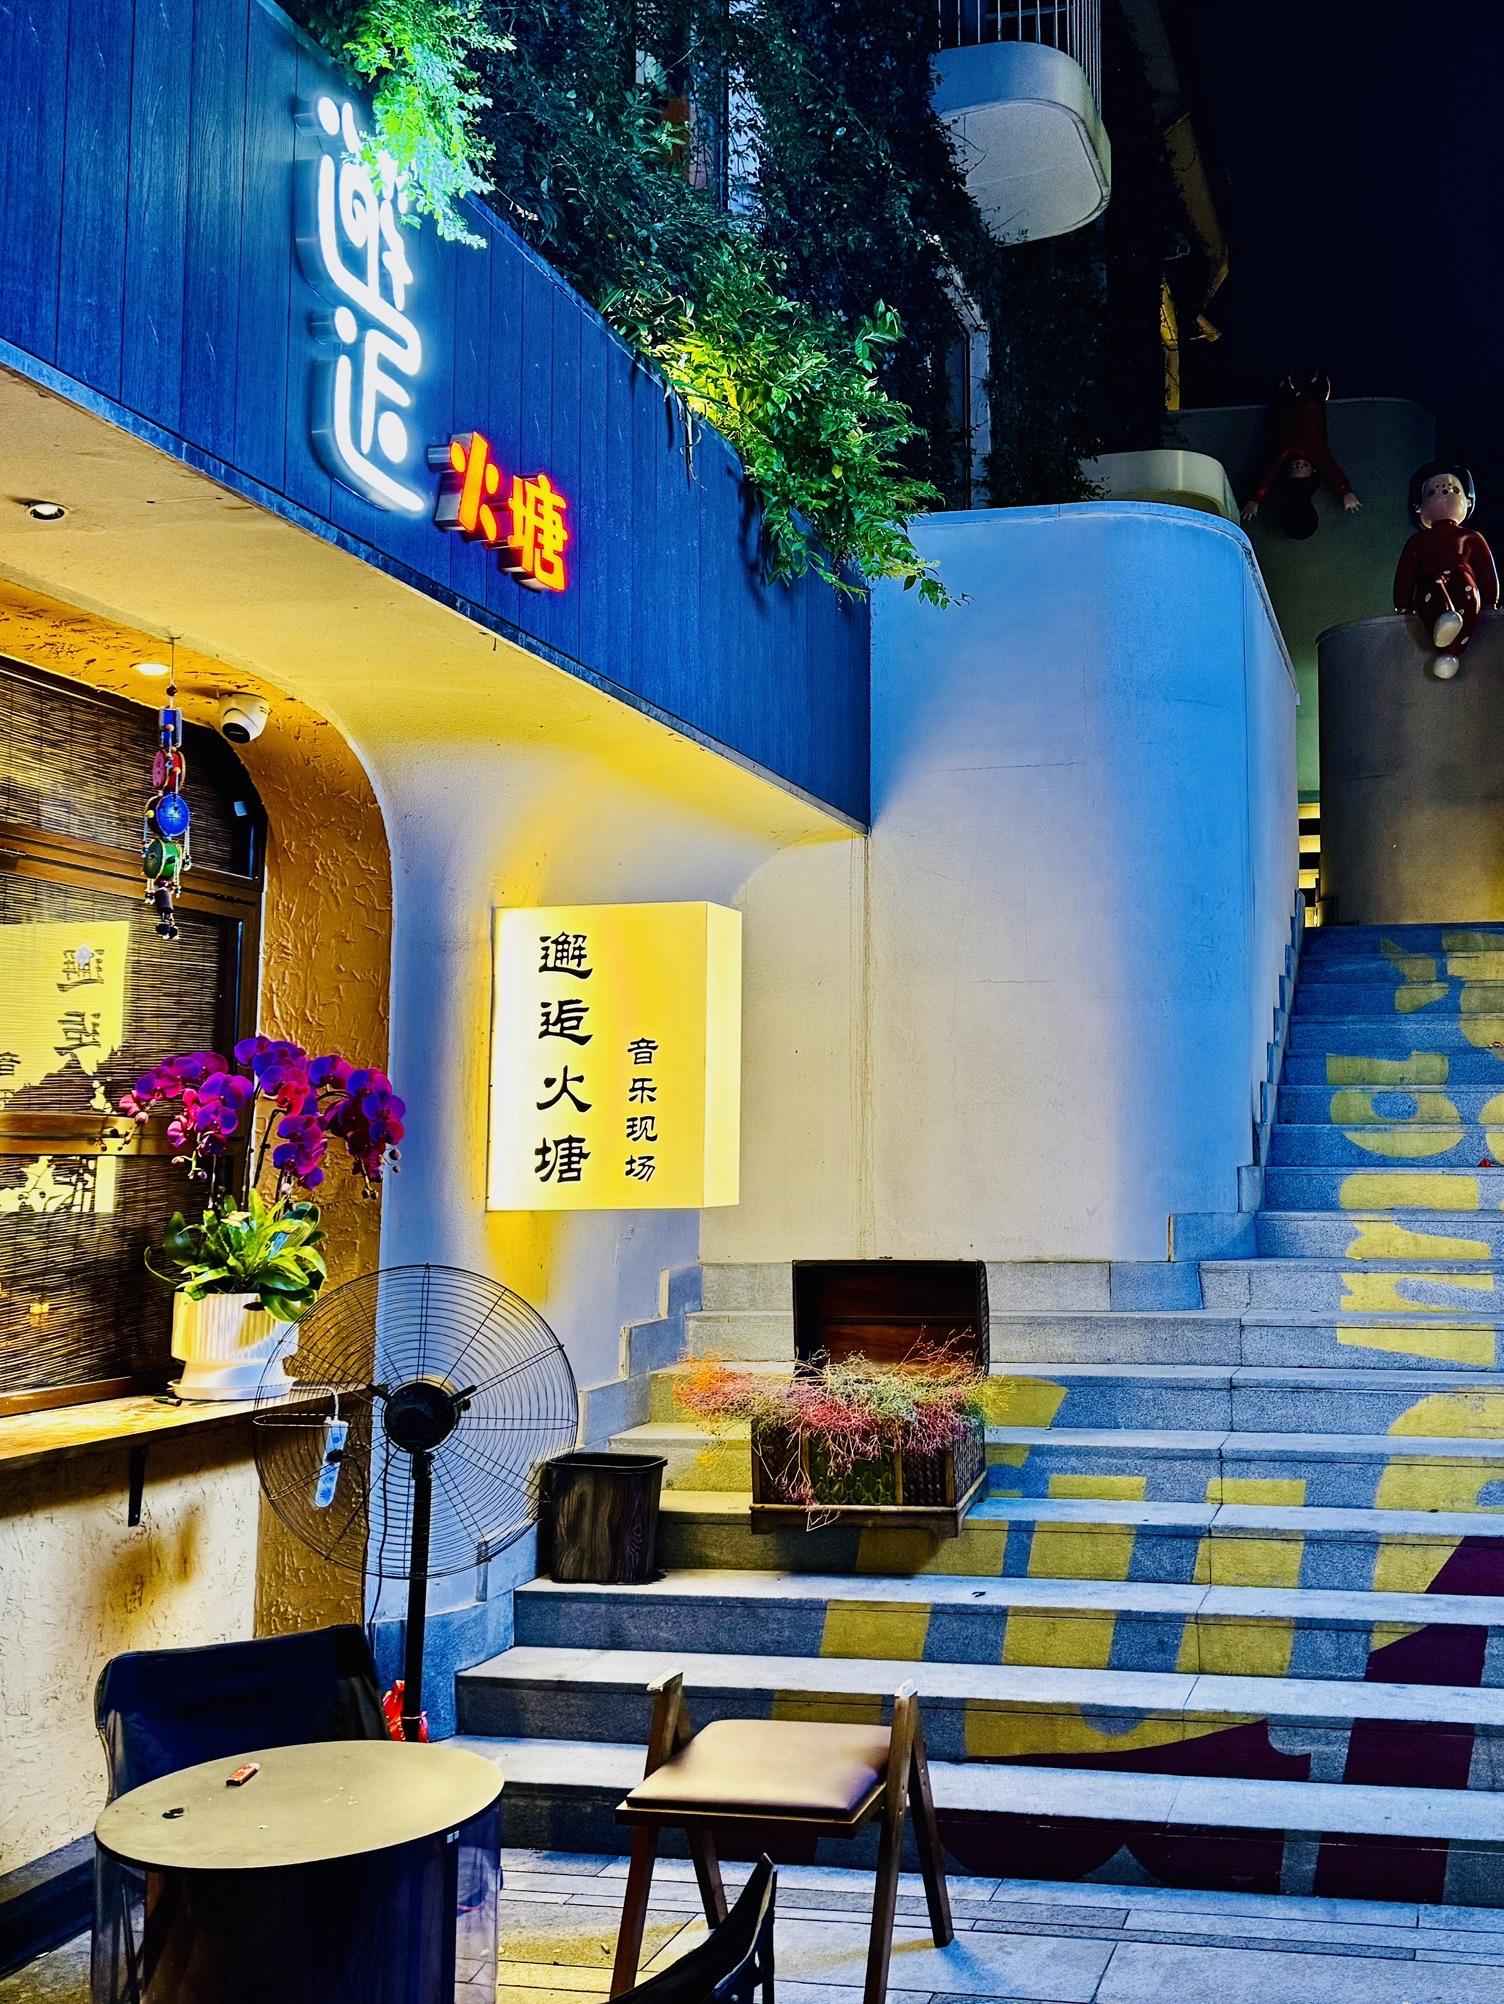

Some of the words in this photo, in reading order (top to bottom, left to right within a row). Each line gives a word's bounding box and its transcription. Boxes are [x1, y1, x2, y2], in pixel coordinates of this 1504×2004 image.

[449, 430, 568, 592] 火塘
[534, 932, 593, 1184] 邂逅火塘
[625, 1037, 659, 1182] 音乐现场
